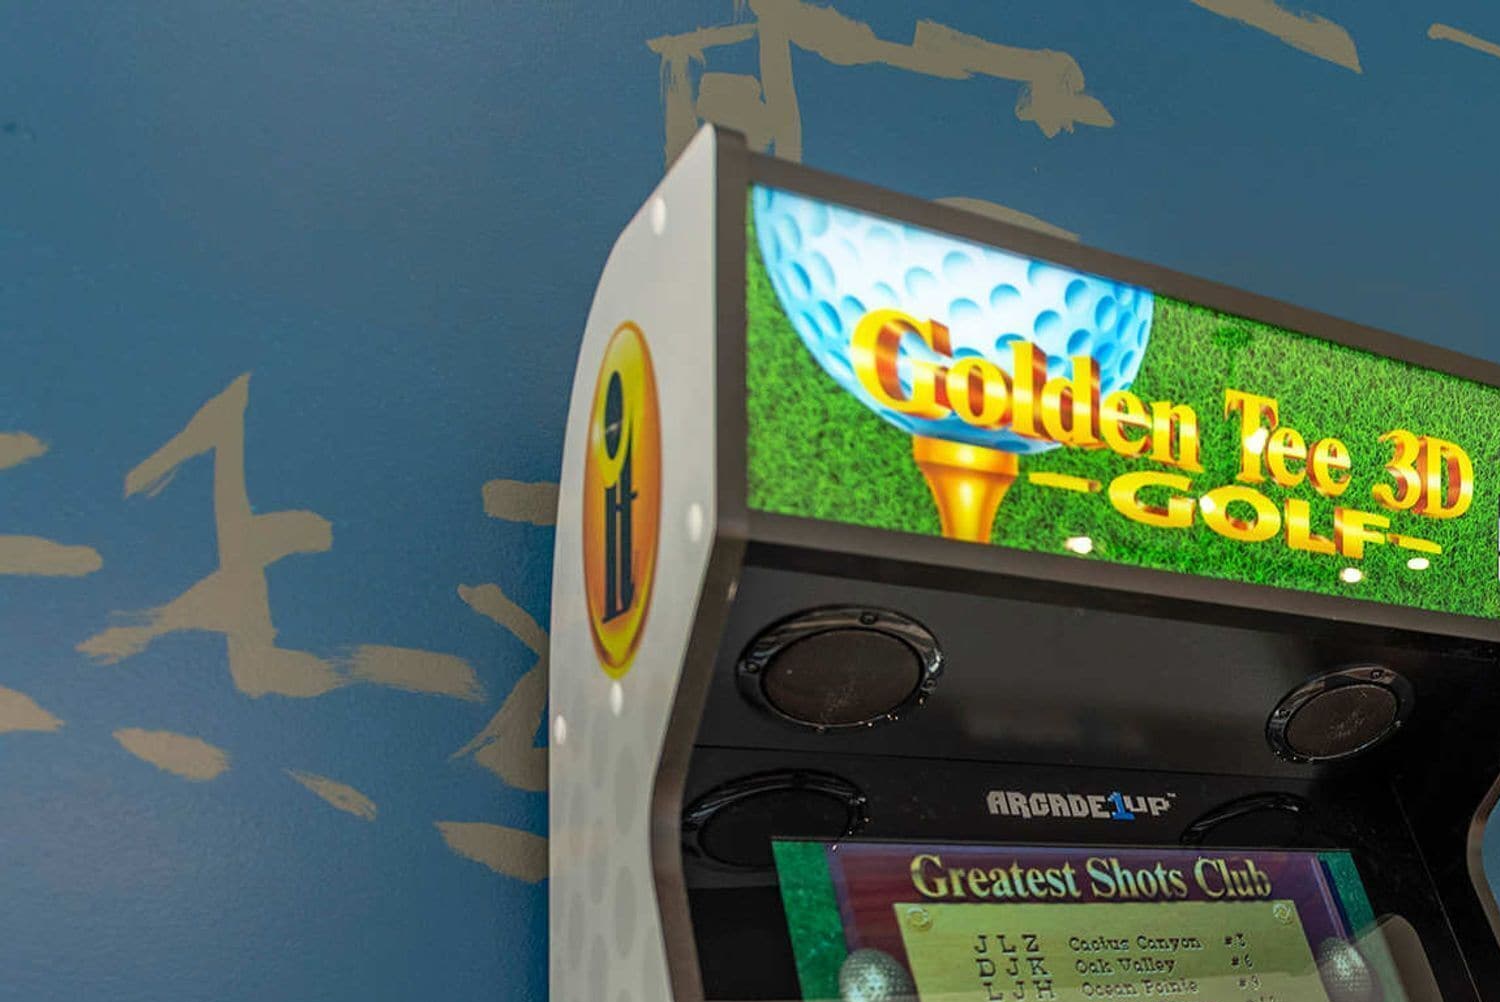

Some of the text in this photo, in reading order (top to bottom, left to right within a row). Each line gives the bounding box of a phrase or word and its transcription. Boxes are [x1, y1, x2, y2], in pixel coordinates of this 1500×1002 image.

[851, 308, 1474, 520] Golden Tee 3D
[1108, 471, 1391, 560] GOLF
[910, 854, 1272, 898] Greatest Shots Club
[1068, 936, 1129, 951] Cactus
[1136, 935, 1202, 951] Canyon
[976, 957, 1049, 977] DJK
